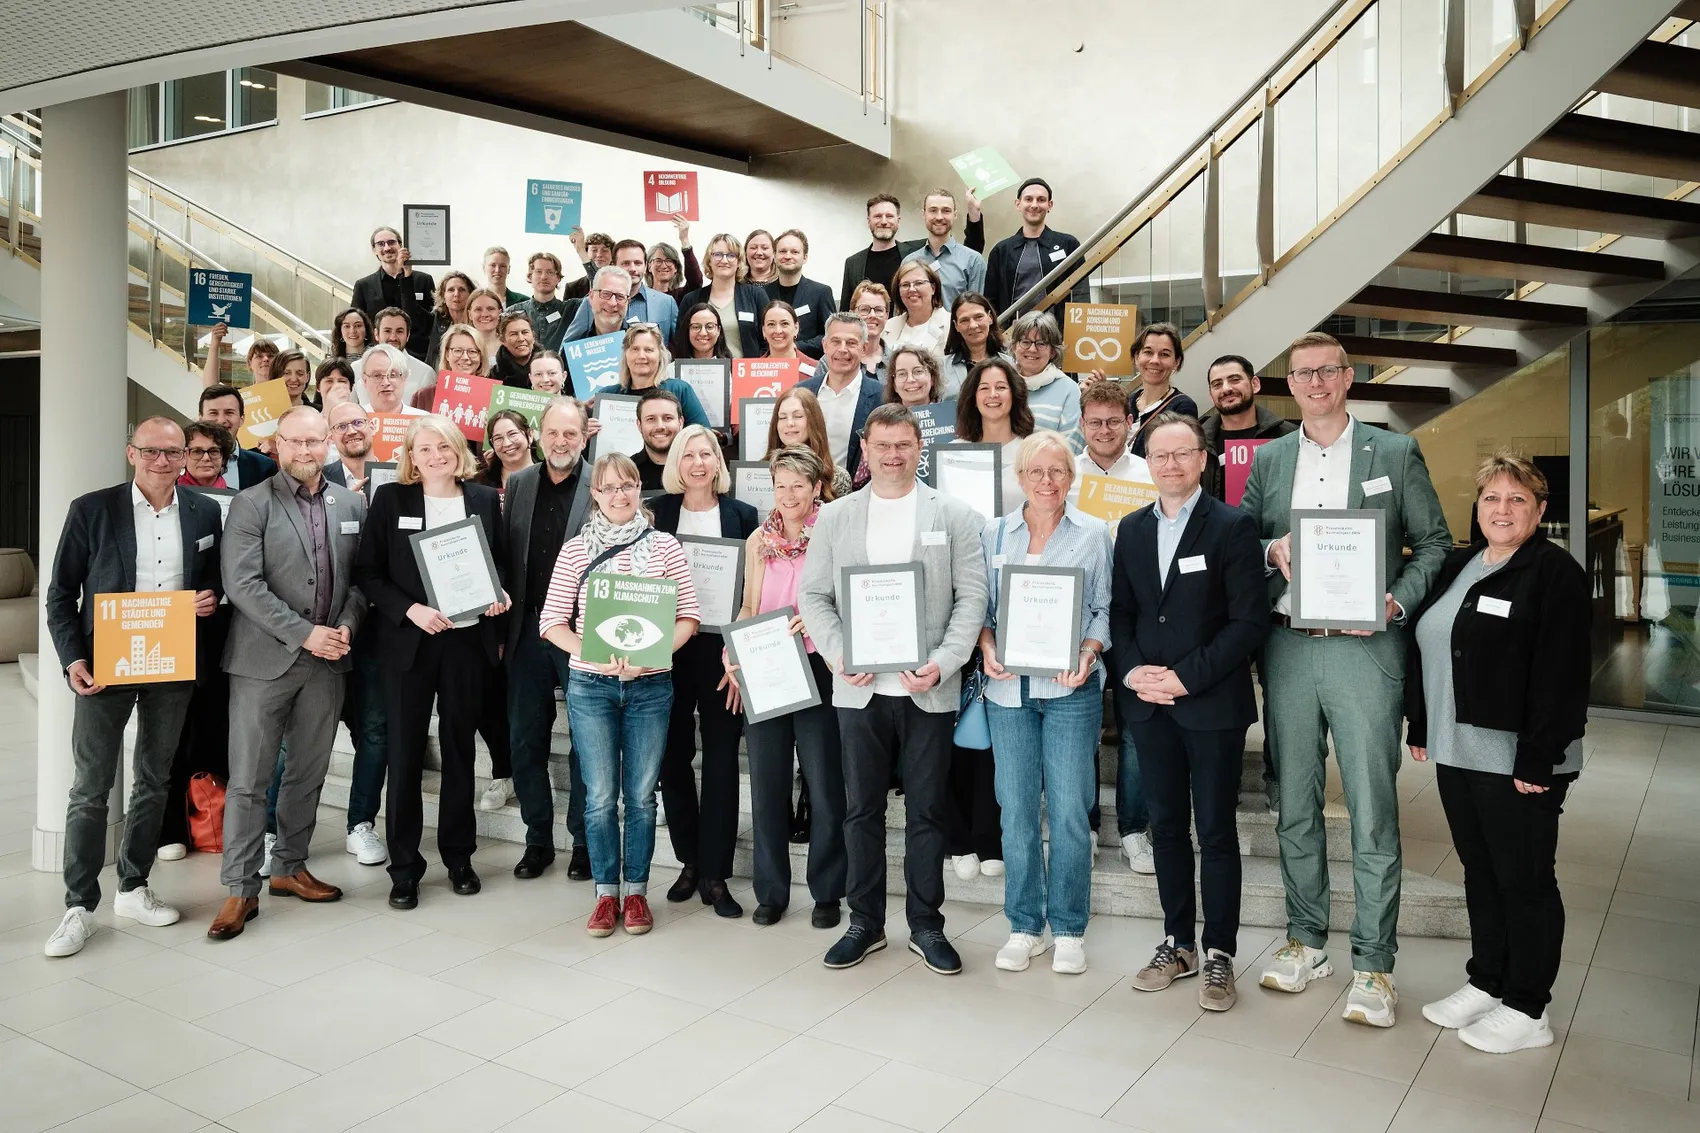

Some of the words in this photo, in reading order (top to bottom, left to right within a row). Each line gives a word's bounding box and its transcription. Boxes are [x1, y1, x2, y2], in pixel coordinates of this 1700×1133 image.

[648, 174, 655, 186] 4
[532, 183, 538, 195] 6
[194, 272, 206, 286] 16
[208, 280, 244, 288] GERECHTIGKEIT
[208, 294, 242, 302] INSTITUTIONEN
[1070, 308, 1082, 324] 12
[1086, 316, 1108, 324] KONSUM
[1086, 325, 1120, 333] PRODUKTION
[568, 344, 582, 360] 14
[738, 362, 746, 378] 5
[444, 375, 450, 389] 1
[456, 377, 470, 385] KEINE
[454, 384, 471, 393] ARMUT
[496, 390, 505, 404] 3
[510, 392, 540, 402] GESUNDHEIT
[921, 425, 954, 437] RREICHUNG
[1230, 446, 1248, 464] 10
[1664, 446, 1690, 460] WIR
[1088, 480, 1098, 499] 7
[1104, 482, 1145, 496] BEZAHLBARE
[1317, 543, 1358, 551] Urkunde
[438, 548, 468, 560] Urkunde
[694, 562, 724, 571] Urkunde
[593, 579, 610, 599] 13
[615, 580, 660, 594] MASSNAHMEN
[661, 585, 676, 594] ZUM
[122, 598, 172, 608] NACHHALTIGE
[614, 591, 659, 604] KLIMASCHUTZ
[1024, 596, 1058, 604] Urkunde
[100, 600, 116, 620] 11
[150, 608, 166, 618] UND
[122, 620, 164, 630] GEMEINDEN
[749, 641, 781, 654] Urkunde
